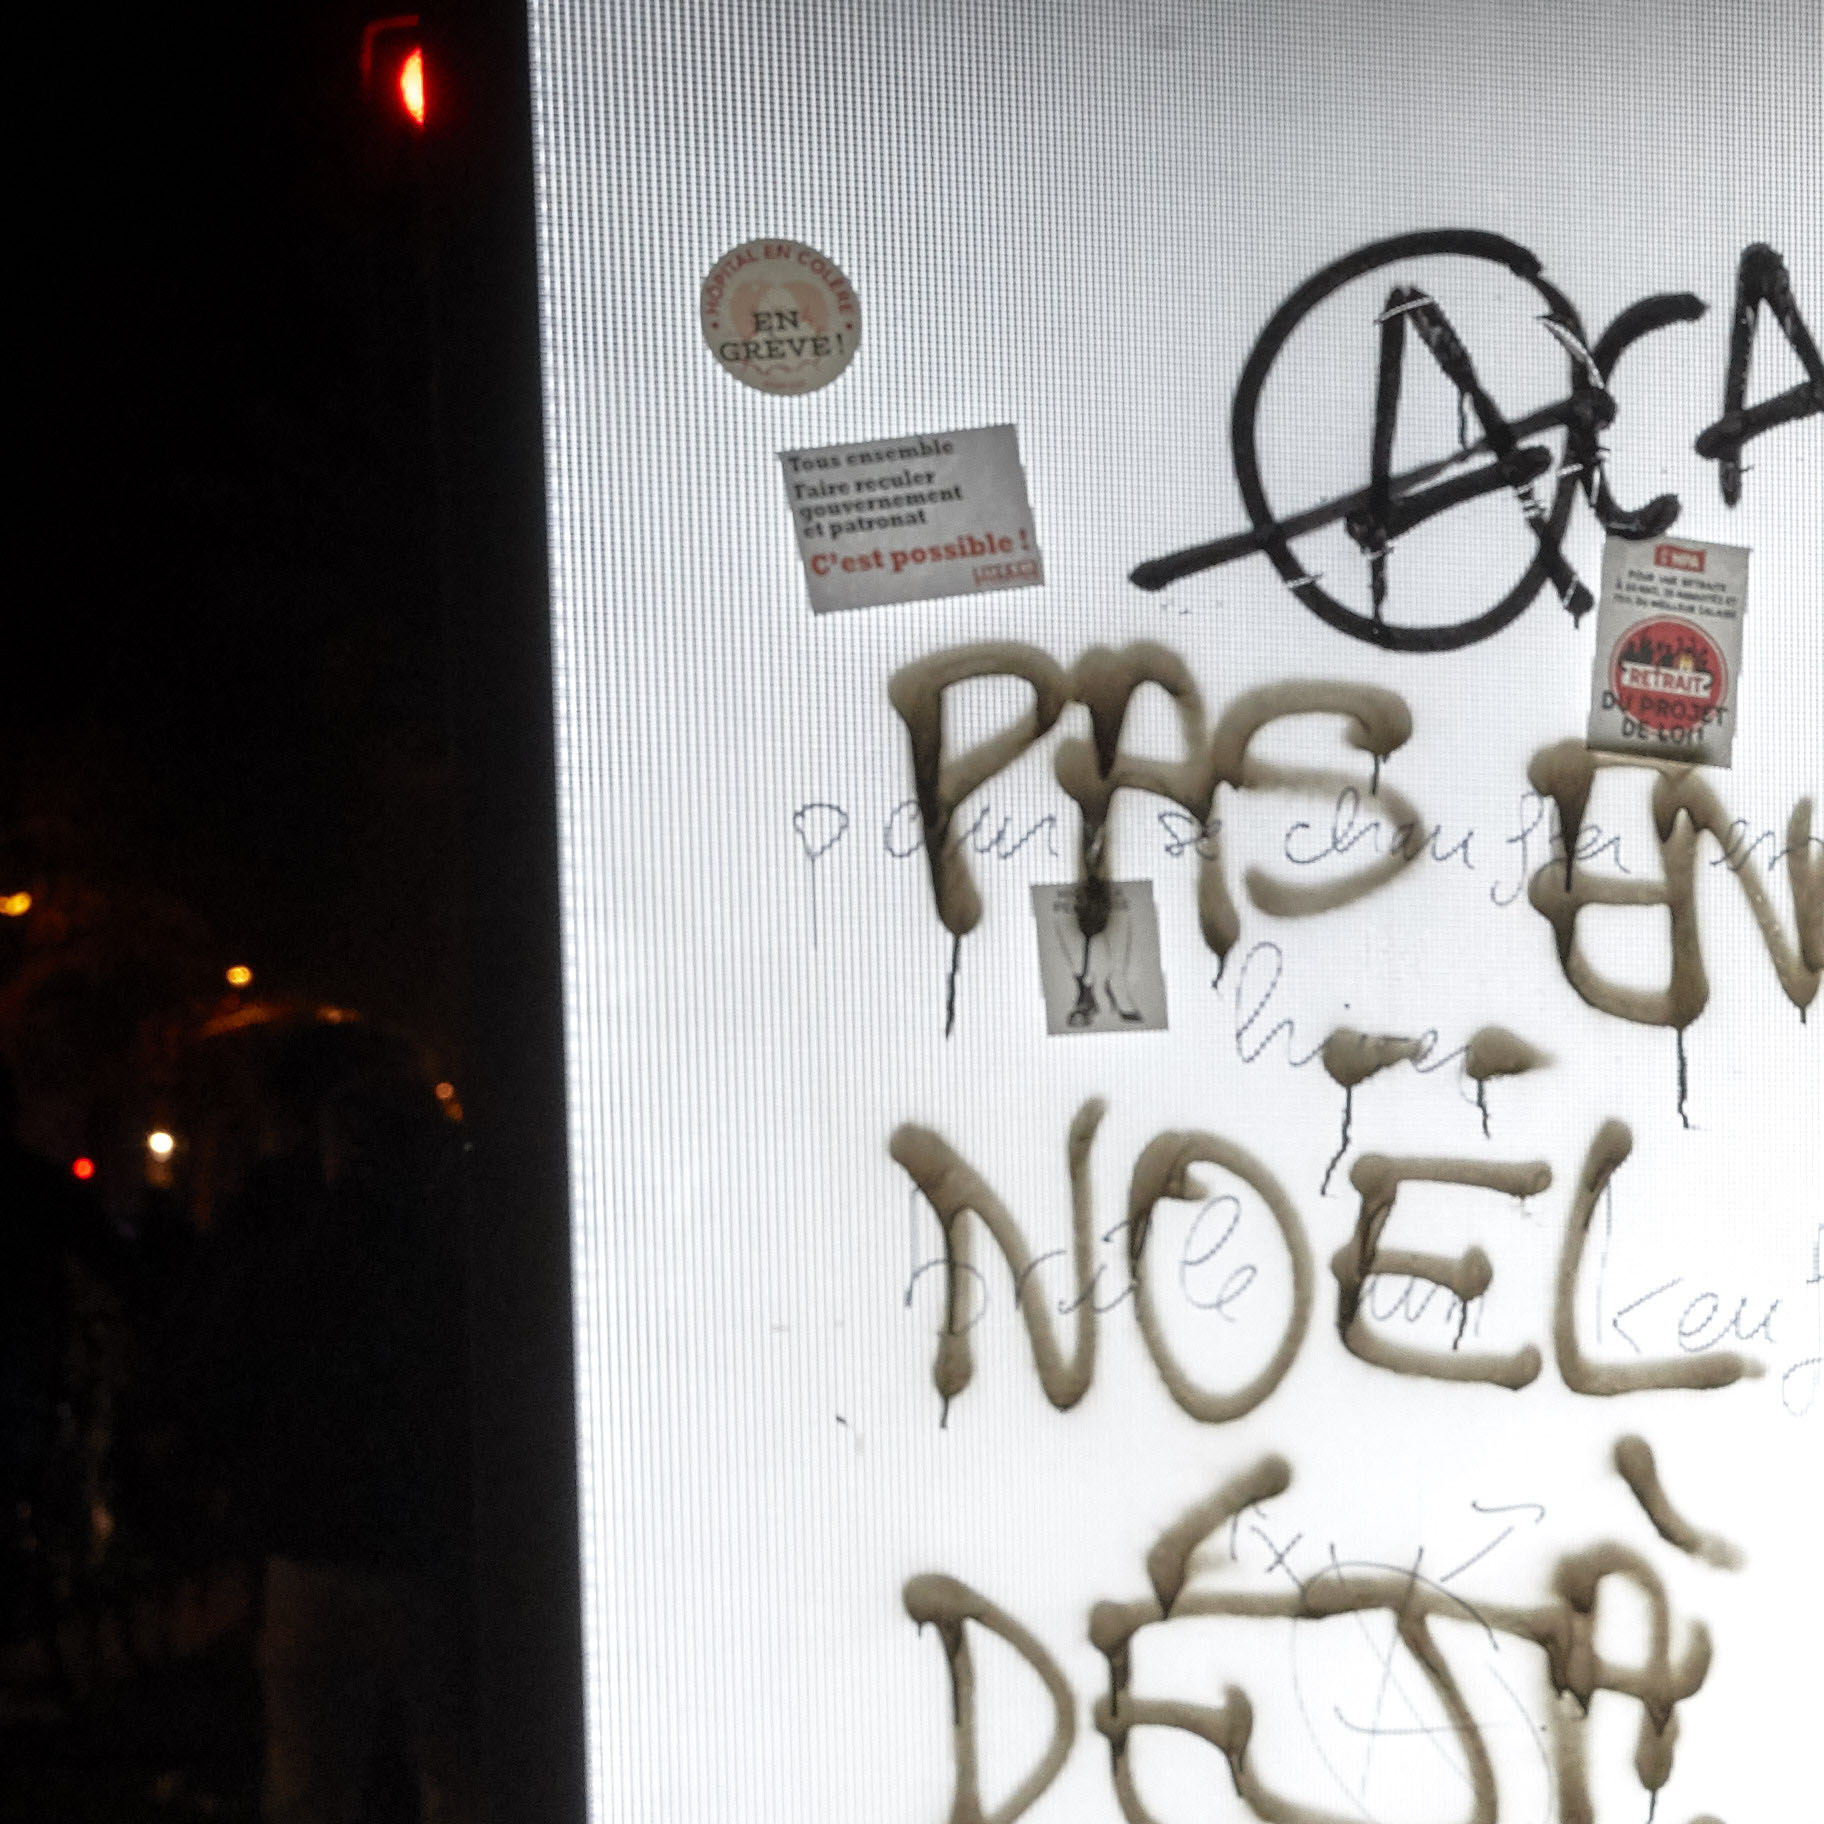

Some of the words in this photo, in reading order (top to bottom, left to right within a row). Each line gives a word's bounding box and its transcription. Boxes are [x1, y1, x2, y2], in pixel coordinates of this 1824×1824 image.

[763, 244, 791, 260] EN
[753, 310, 800, 332] EN
[789, 455, 842, 473] Tous
[846, 438, 955, 467] ensemble
[793, 478, 850, 500] Faire
[856, 469, 937, 494] reculer
[799, 484, 963, 522] gouvernement
[803, 522, 824, 539] et
[829, 509, 927, 541] patronat
[810, 547, 883, 576] C'est
[890, 530, 1013, 573] possible
[1630, 667, 1705, 694] RETRAIT
[1602, 691, 1632, 713] DU
[1640, 697, 1728, 725] PROJET
[1622, 717, 1649, 739] DE
[887, 640, 1428, 960] PAS
